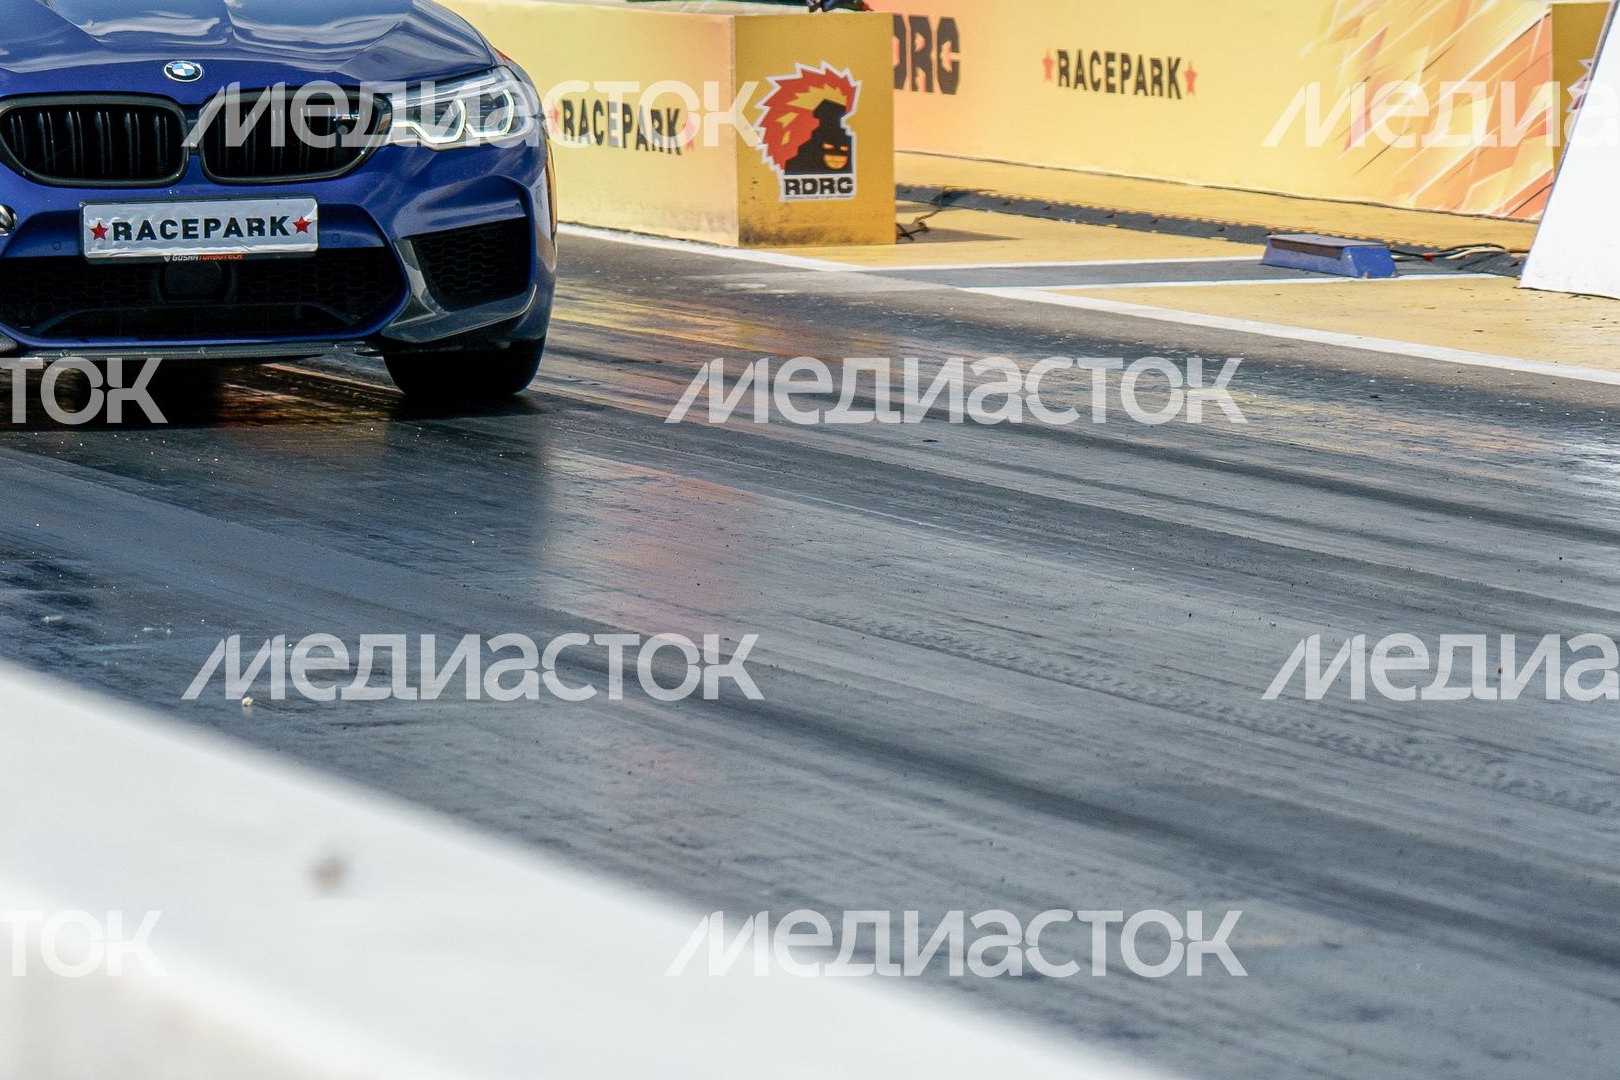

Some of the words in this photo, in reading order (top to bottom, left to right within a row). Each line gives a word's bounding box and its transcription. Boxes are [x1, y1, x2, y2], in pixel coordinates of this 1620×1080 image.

[1057, 48, 1183, 100] RACEPARK
[561, 98, 682, 155] RACEPARK
[784, 177, 853, 195] RDRC
[111, 216, 291, 242] RACEPARK
